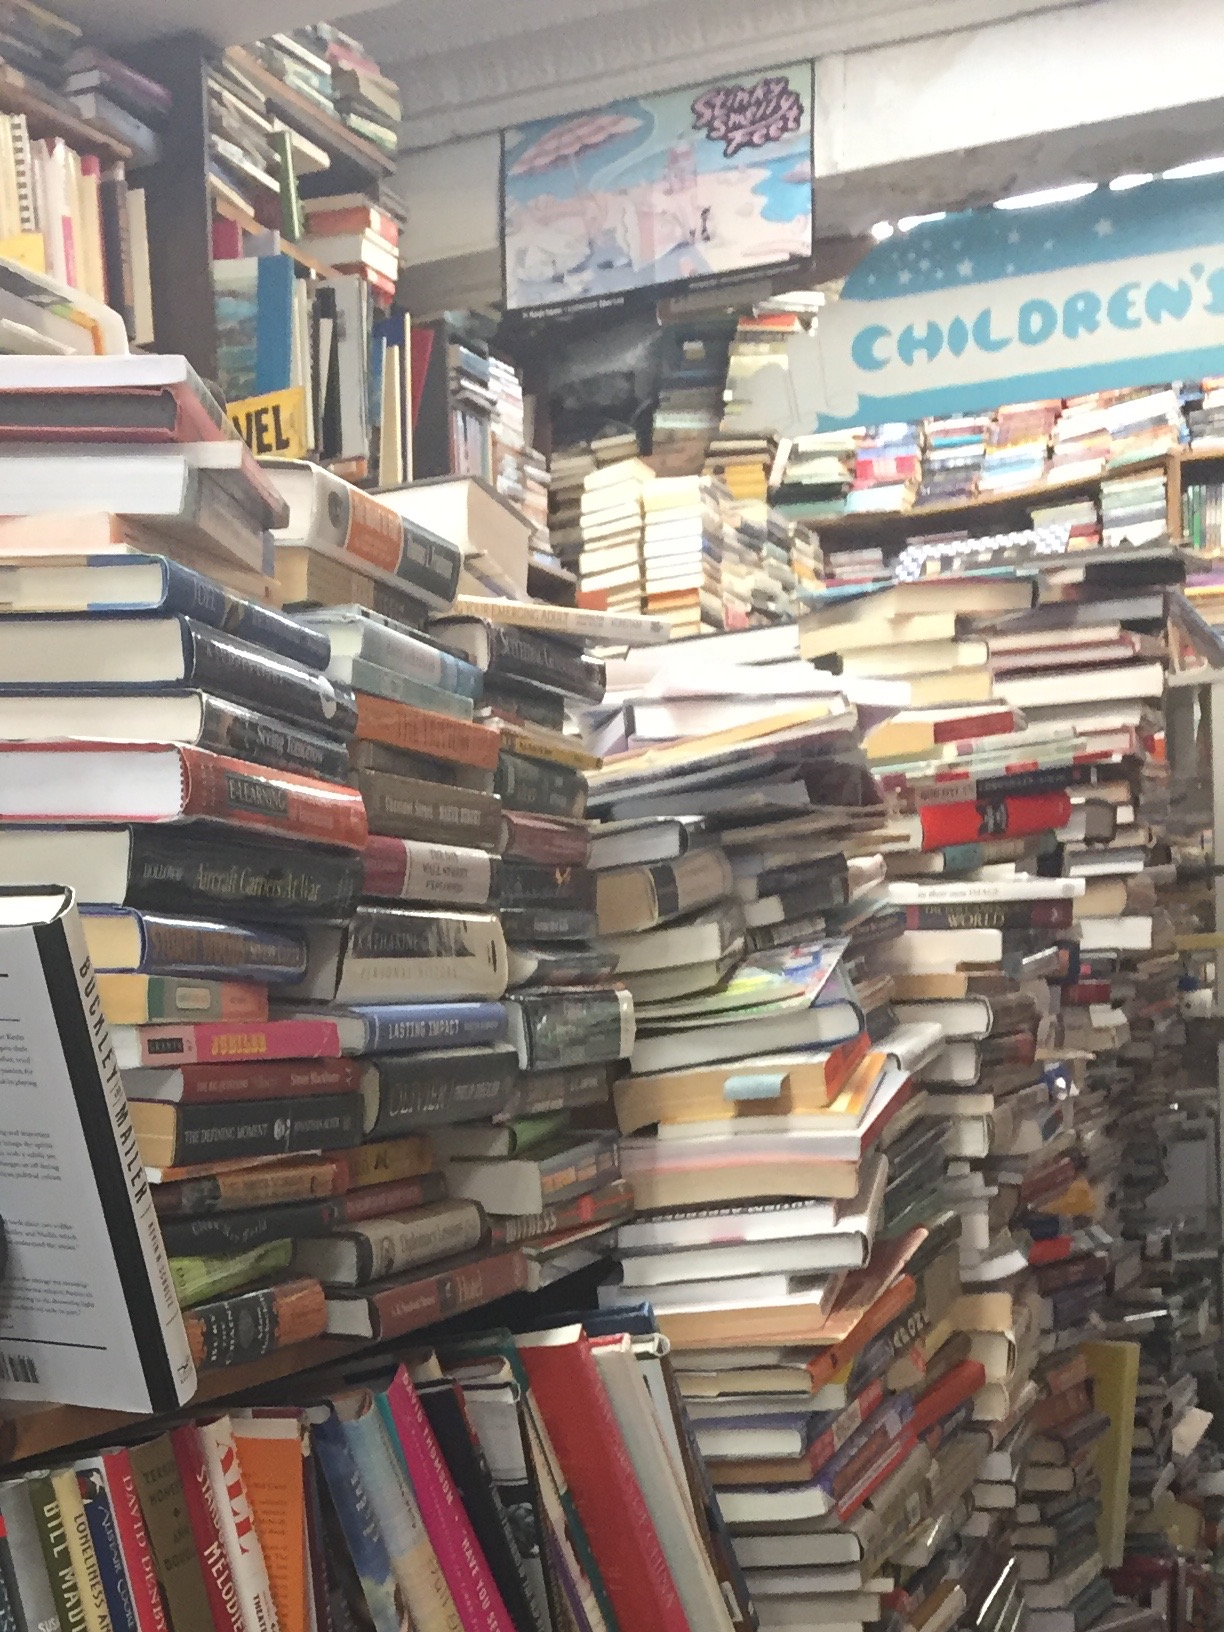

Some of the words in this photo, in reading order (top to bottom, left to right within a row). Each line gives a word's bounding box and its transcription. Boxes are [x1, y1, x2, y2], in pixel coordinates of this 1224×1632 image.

[389, 1023, 425, 1039] LASTING
[428, 1020, 459, 1036] IMPACT
[78, 962, 119, 1086] BUCKLEY
[115, 1104, 148, 1206] MAILER
[43, 1501, 66, 1558] BILL
[74, 1513, 101, 1609] LONELINESS
[123, 1475, 146, 1548] DAVID
[141, 1556, 166, 1632] DENBY
